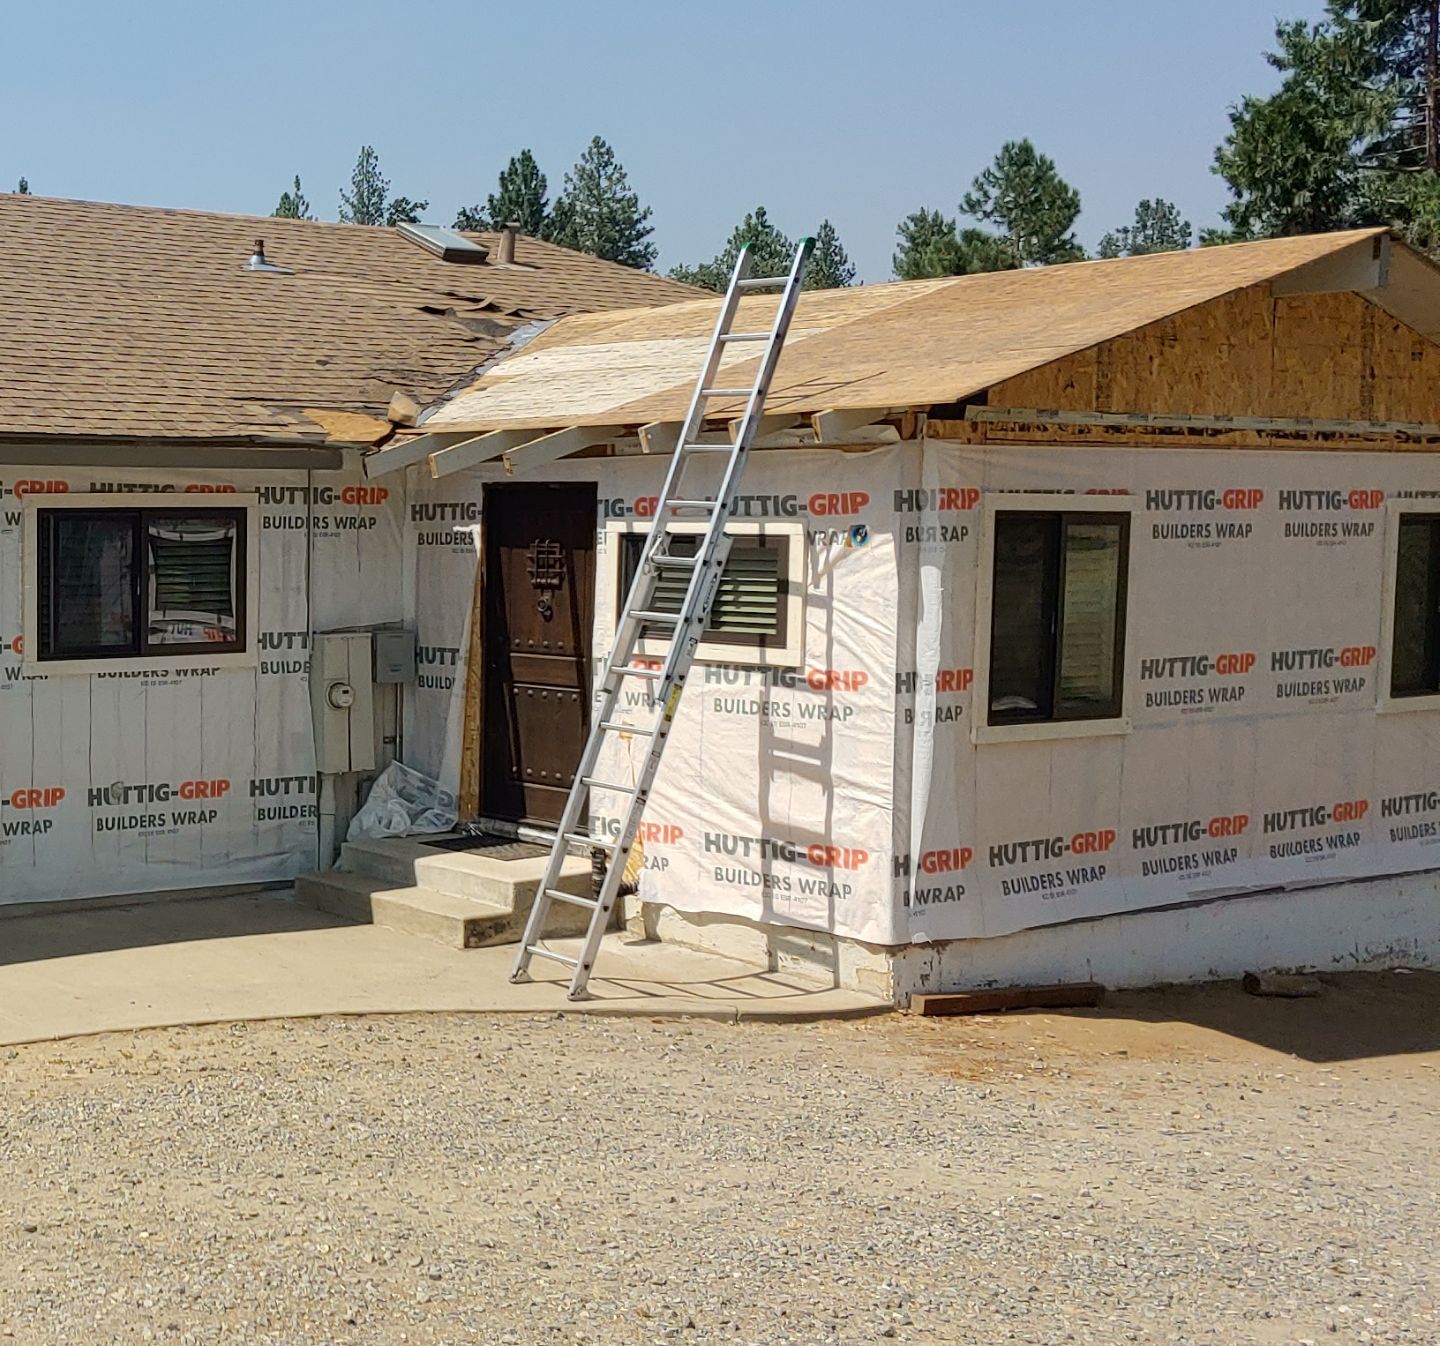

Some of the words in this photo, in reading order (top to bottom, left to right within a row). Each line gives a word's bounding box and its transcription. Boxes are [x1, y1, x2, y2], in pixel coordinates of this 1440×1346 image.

[255, 486, 389, 505] HUTTIG-GRIP
[1146, 488, 1263, 511] HUTTIG-GRIP
[1278, 489, 1384, 511] HUTTIG-GRIP
[410, 502, 484, 521] HUTTIG-
[334, 516, 376, 529] WRAP
[1152, 523, 1210, 539] BUILDERS
[1216, 522, 1252, 538] WRAP
[1284, 522, 1338, 538] BUILDERS
[1342, 522, 1374, 537] WRAP
[418, 532, 473, 545] BUILDERS
[940, 526, 968, 542] RAP
[258, 632, 307, 650] HUTT
[415, 646, 460, 665] HUTT
[1271, 646, 1376, 672] HUTTIG-GRIP
[261, 661, 311, 674] BUILDE
[1141, 653, 1255, 680] HUTTIG-GRIP
[418, 675, 455, 689] BUILD
[704, 665, 869, 692] HUTTIG-GRIP
[1277, 679, 1330, 698] BUILDERS
[1334, 677, 1365, 694] WRAP
[1145, 688, 1204, 708] BUILDERS
[1209, 685, 1245, 702] WRAP
[714, 698, 791, 718] BUILDERS
[798, 702, 854, 722] WRAP
[935, 705, 963, 723] RAP
[250, 776, 315, 797] HUTTI
[97, 813, 165, 832] BUILDERS
[172, 810, 217, 826] WRAP
[258, 804, 317, 821] BUILDER
[1263, 799, 1368, 833] HUTTIG-GRIP
[3, 819, 53, 837] WRAP
[1132, 814, 1249, 849] HUTTIG-GRIP
[1389, 823, 1437, 842] BUILDERS
[705, 832, 868, 870] HUTTIG-GRIP
[989, 829, 1116, 867] HUTTIG-GRIP
[1269, 840, 1321, 859] BUILDERS
[1326, 832, 1360, 849] WRAP
[643, 855, 669, 871] RAP
[1142, 854, 1199, 877] BUILDERS
[1203, 848, 1238, 866] WRAP
[714, 866, 791, 891] BUILDERS
[798, 877, 852, 899] WRAP
[1002, 873, 1064, 897] BUILDERS
[1068, 865, 1106, 887] WRAP
[915, 885, 965, 905] WRAP
